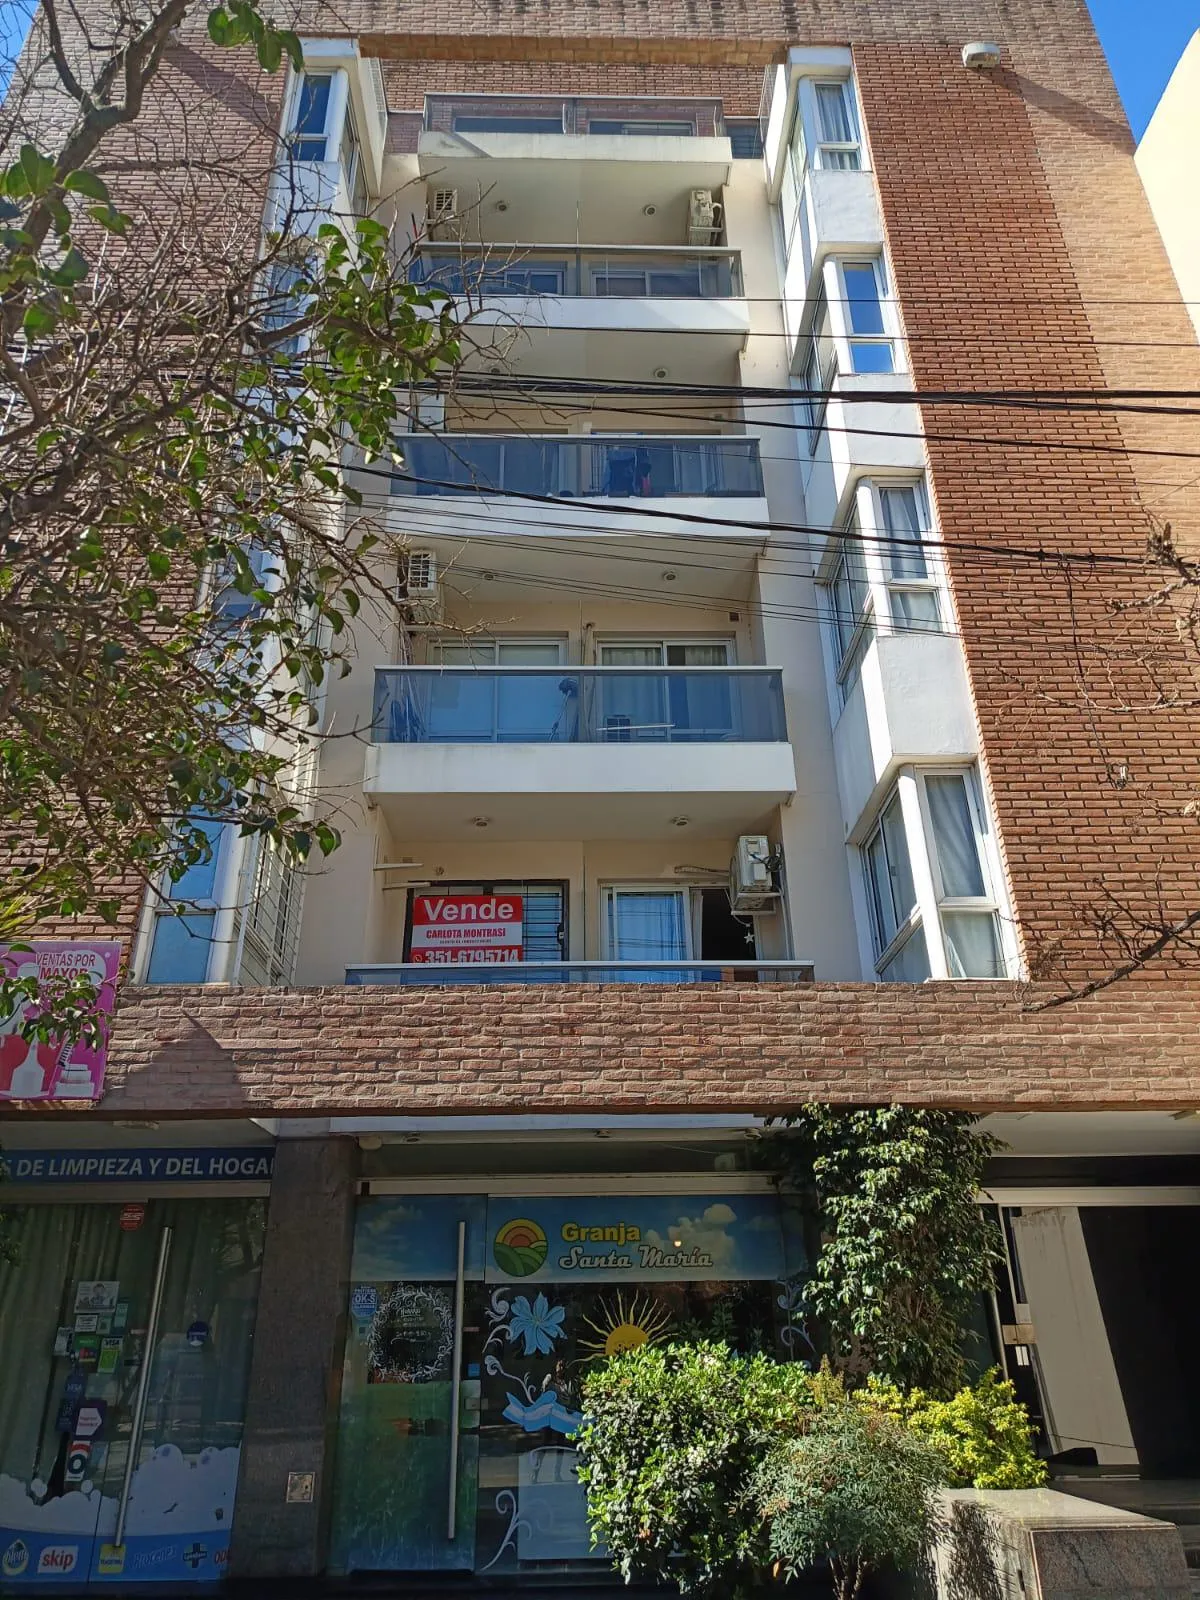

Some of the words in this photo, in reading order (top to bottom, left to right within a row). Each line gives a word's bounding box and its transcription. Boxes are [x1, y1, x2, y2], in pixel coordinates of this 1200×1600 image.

[424, 899, 514, 921] Vende
[426, 928, 462, 939] CARLOTA
[463, 927, 506, 938] MONTRASI
[35, 952, 74, 967] VENTAS
[74, 953, 96, 967] POR
[424, 949, 519, 963] 351-6795714
[40, 967, 88, 980] MAYO
[16, 1159, 45, 1177] DE
[48, 1158, 143, 1176] LIMPIEZA
[149, 1158, 163, 1175] Y
[165, 1158, 204, 1175] DEL
[208, 1157, 274, 1175] HOGA
[561, 1221, 641, 1246] Granja
[559, 1245, 632, 1269] Santa
[638, 1245, 714, 1268] María
[42, 1550, 74, 1570] skip
